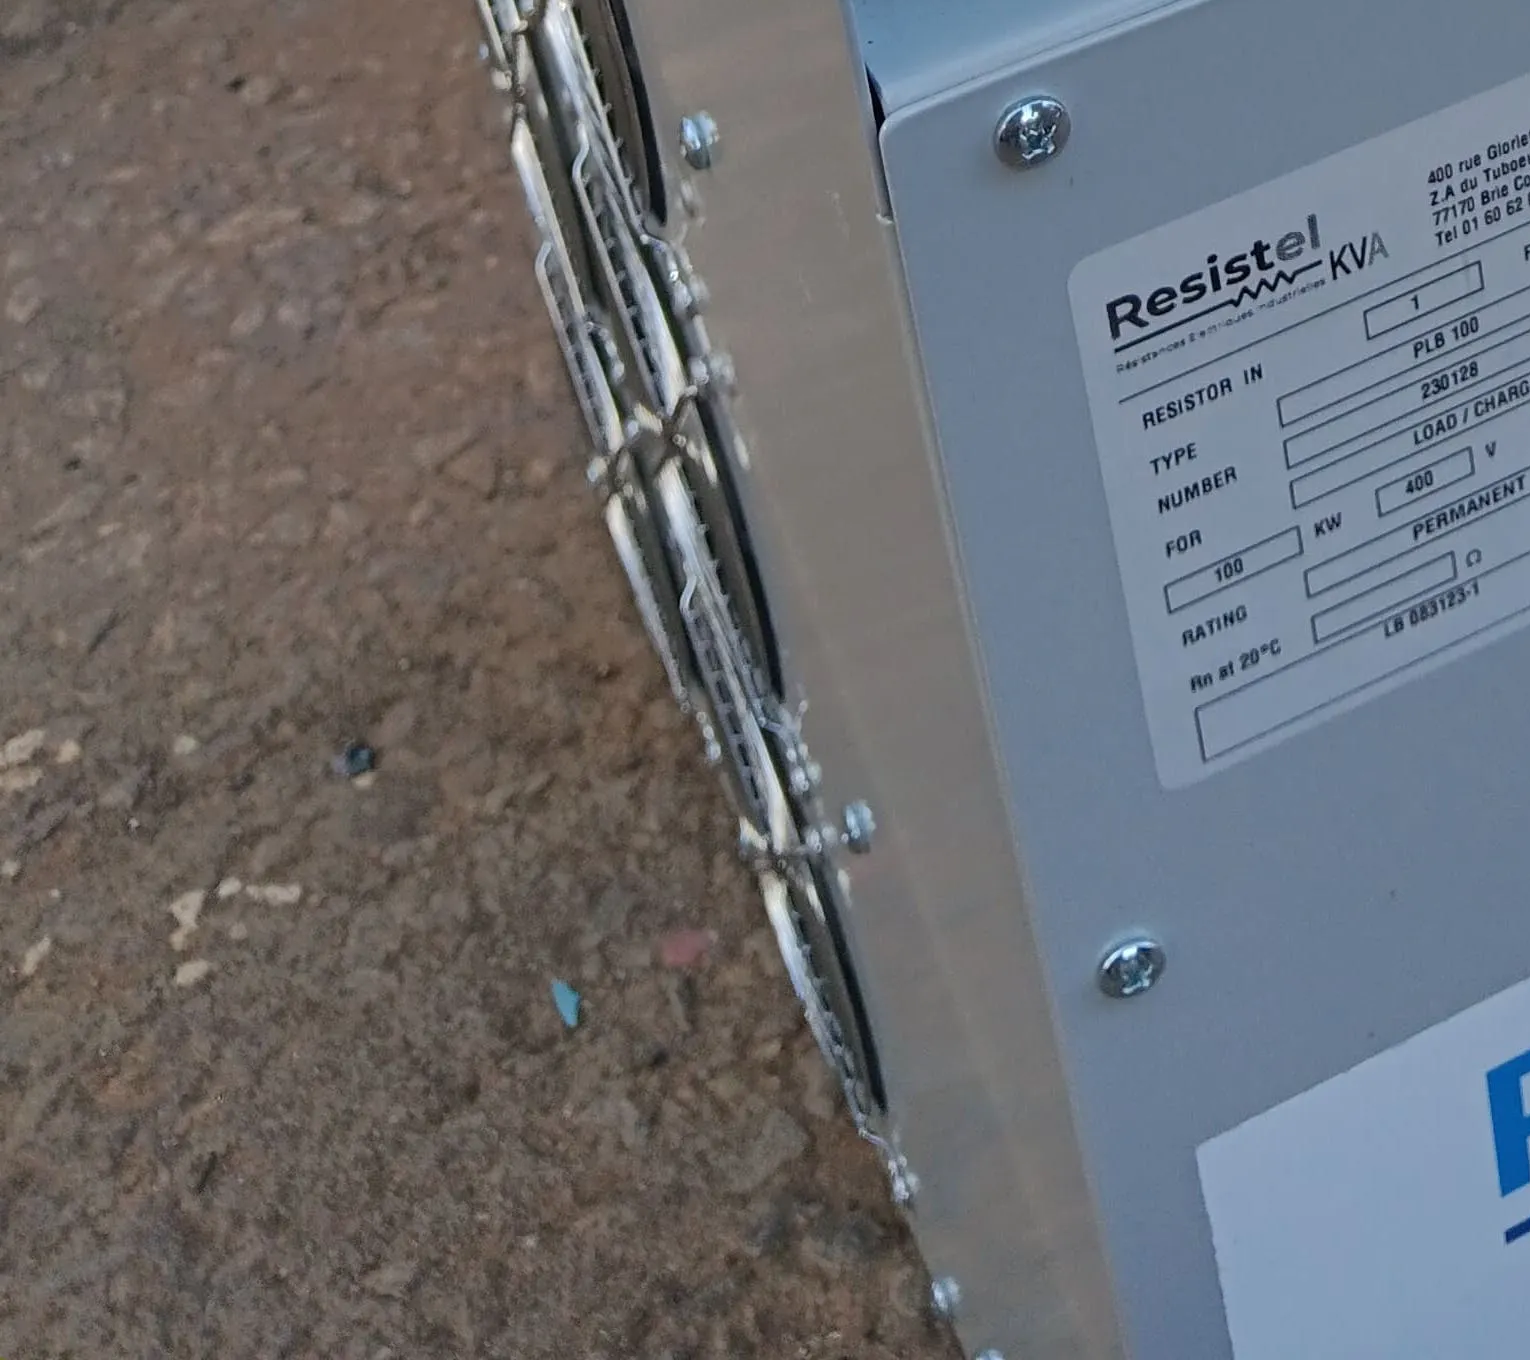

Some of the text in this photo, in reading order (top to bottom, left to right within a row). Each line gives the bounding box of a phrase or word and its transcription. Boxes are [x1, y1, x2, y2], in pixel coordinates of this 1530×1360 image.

[1428, 163, 1453, 184] 400
[1459, 154, 1482, 173] rue
[1430, 187, 1455, 206] Z.A
[1460, 178, 1478, 194] du
[1432, 198, 1475, 226] 77170
[1481, 185, 1509, 206] Brie
[1435, 227, 1458, 247] Tel
[1462, 218, 1479, 236] 01
[1484, 207, 1501, 225] 60
[1506, 198, 1523, 216] 62
[1106, 213, 1321, 341] Resistel
[1329, 232, 1390, 281] KVA
[1411, 295, 1419, 310] 1
[1413, 316, 1479, 359] PLB 100
[1142, 363, 1263, 430] RESISTOR IN
[1421, 361, 1478, 400] 230128
[1414, 412, 1457, 446] LOAD
[1150, 442, 1197, 476] TYPE
[1405, 442, 1497, 494] 400 V
[1158, 466, 1237, 515] NUMBER
[1413, 474, 1526, 541] PERMANENT
[1165, 529, 1202, 558] FOR
[1214, 512, 1343, 583] 100 KW
[1182, 605, 1248, 648] RATING
[1218, 662, 1234, 678] at
